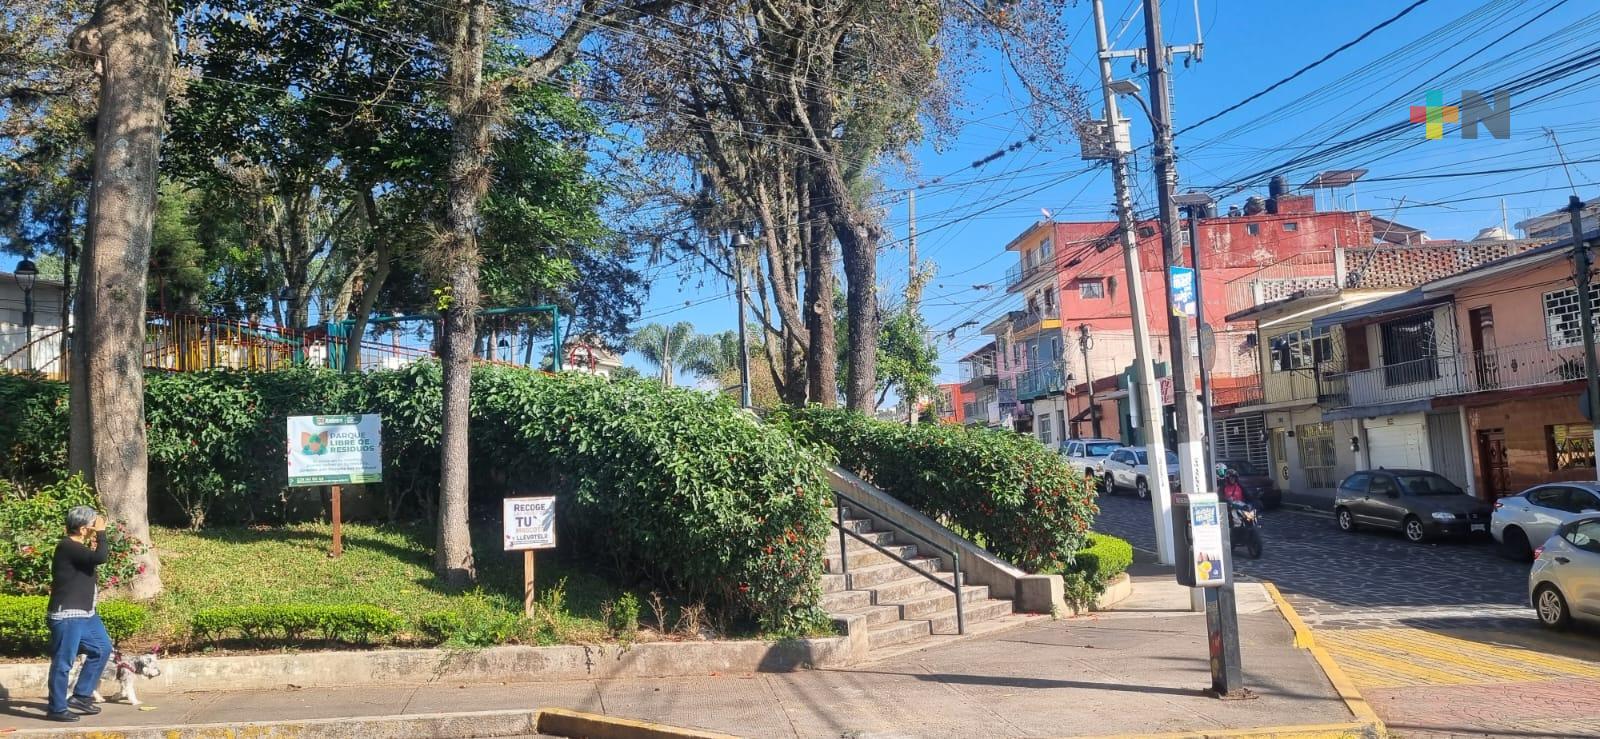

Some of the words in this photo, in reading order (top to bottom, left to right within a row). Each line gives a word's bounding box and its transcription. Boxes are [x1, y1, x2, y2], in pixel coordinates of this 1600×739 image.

[330, 445, 375, 453] RESIDUOS
[514, 503, 545, 511] RECOGE
[515, 516, 532, 527] TU
